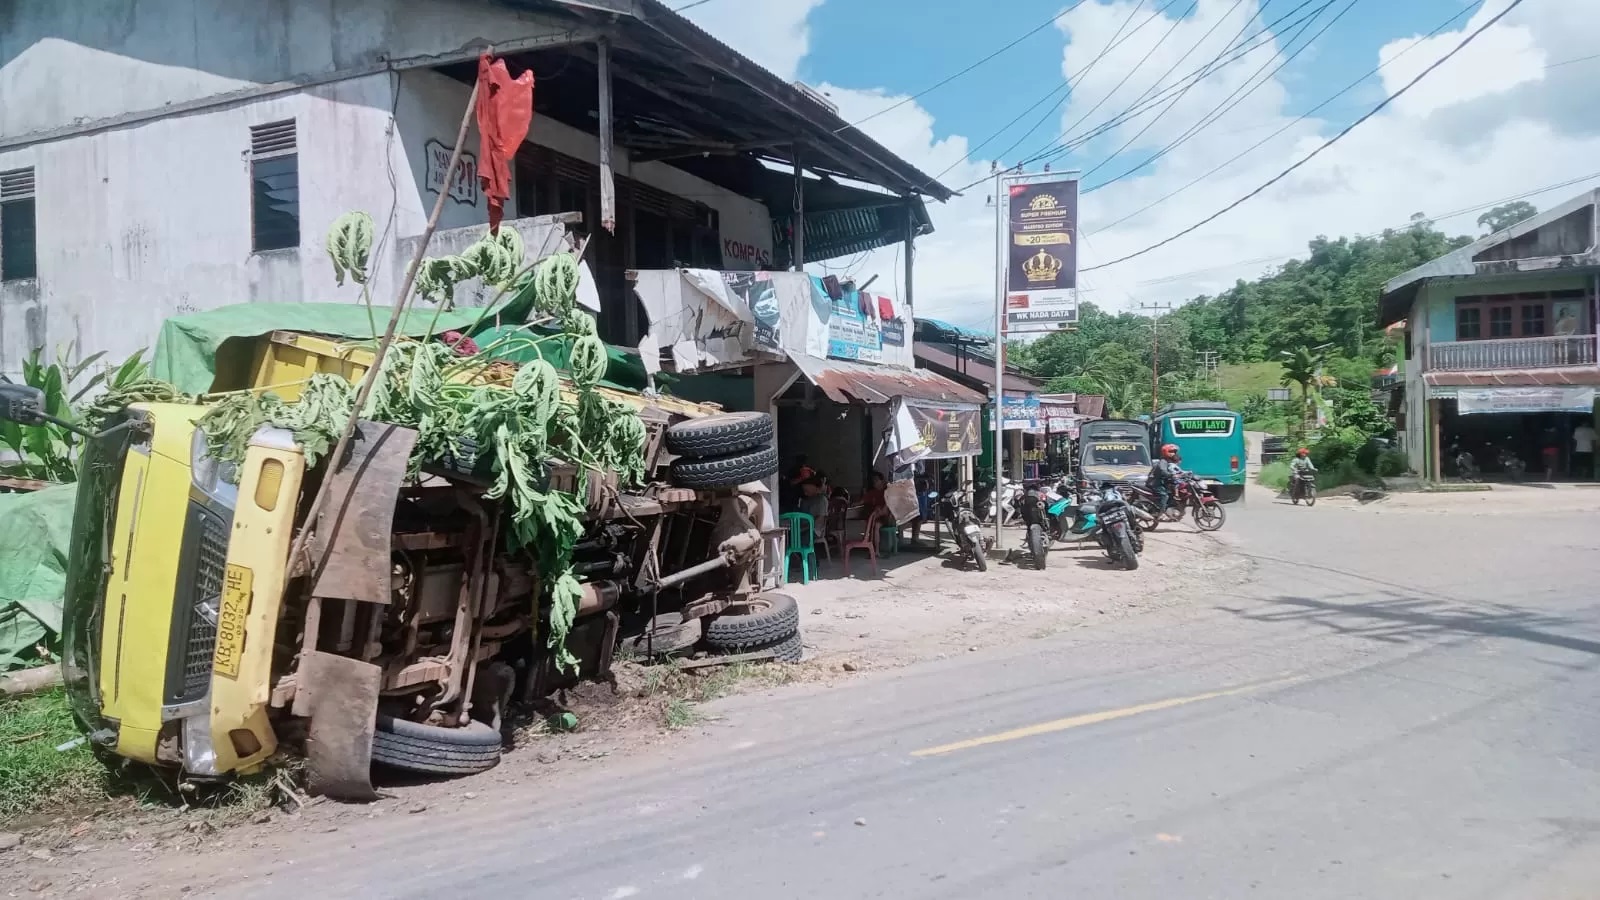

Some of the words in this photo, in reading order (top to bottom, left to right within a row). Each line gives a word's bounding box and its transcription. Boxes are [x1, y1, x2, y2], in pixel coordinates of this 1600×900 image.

[1040, 209, 1067, 217] PREMIUM
[723, 238, 769, 265] KOMPAS
[1016, 312, 1028, 320] WK
[1051, 310, 1070, 318] DATA
[1179, 419, 1203, 430] TUAH
[1205, 419, 1226, 430] LAYO
[226, 570, 243, 591] HE
[219, 601, 238, 641] 8032
[215, 647, 232, 667] KB
